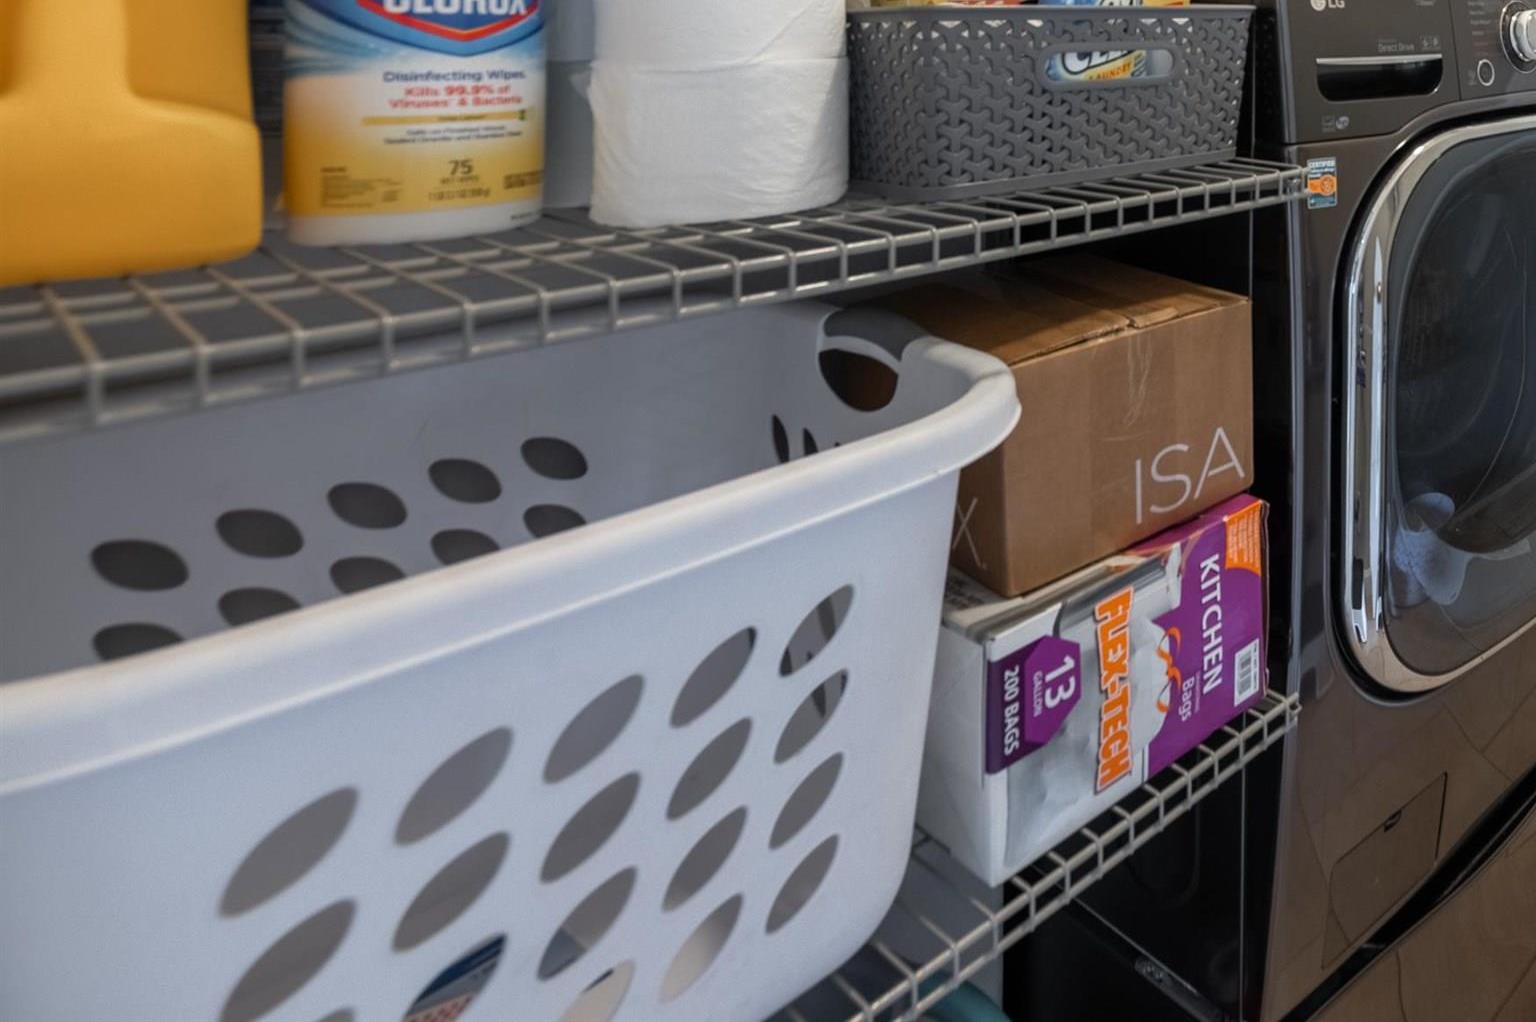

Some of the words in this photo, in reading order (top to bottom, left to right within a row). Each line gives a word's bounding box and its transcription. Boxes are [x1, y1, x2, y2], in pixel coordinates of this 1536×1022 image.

[383, 69, 482, 83] Disinfecting
[486, 68, 525, 82] Wipes
[405, 85, 439, 97] Kills
[447, 159, 474, 176] 75
[1136, 426, 1246, 525] ISA
[1200, 553, 1223, 696] KITCHEN
[1003, 665, 1020, 701] 200
[1032, 670, 1043, 717] GALLON
[1044, 655, 1076, 709] 13
[1093, 584, 1135, 796] FLEX-TECH
[1178, 676, 1195, 722] Bags
[1003, 708, 1021, 756] BAGS
